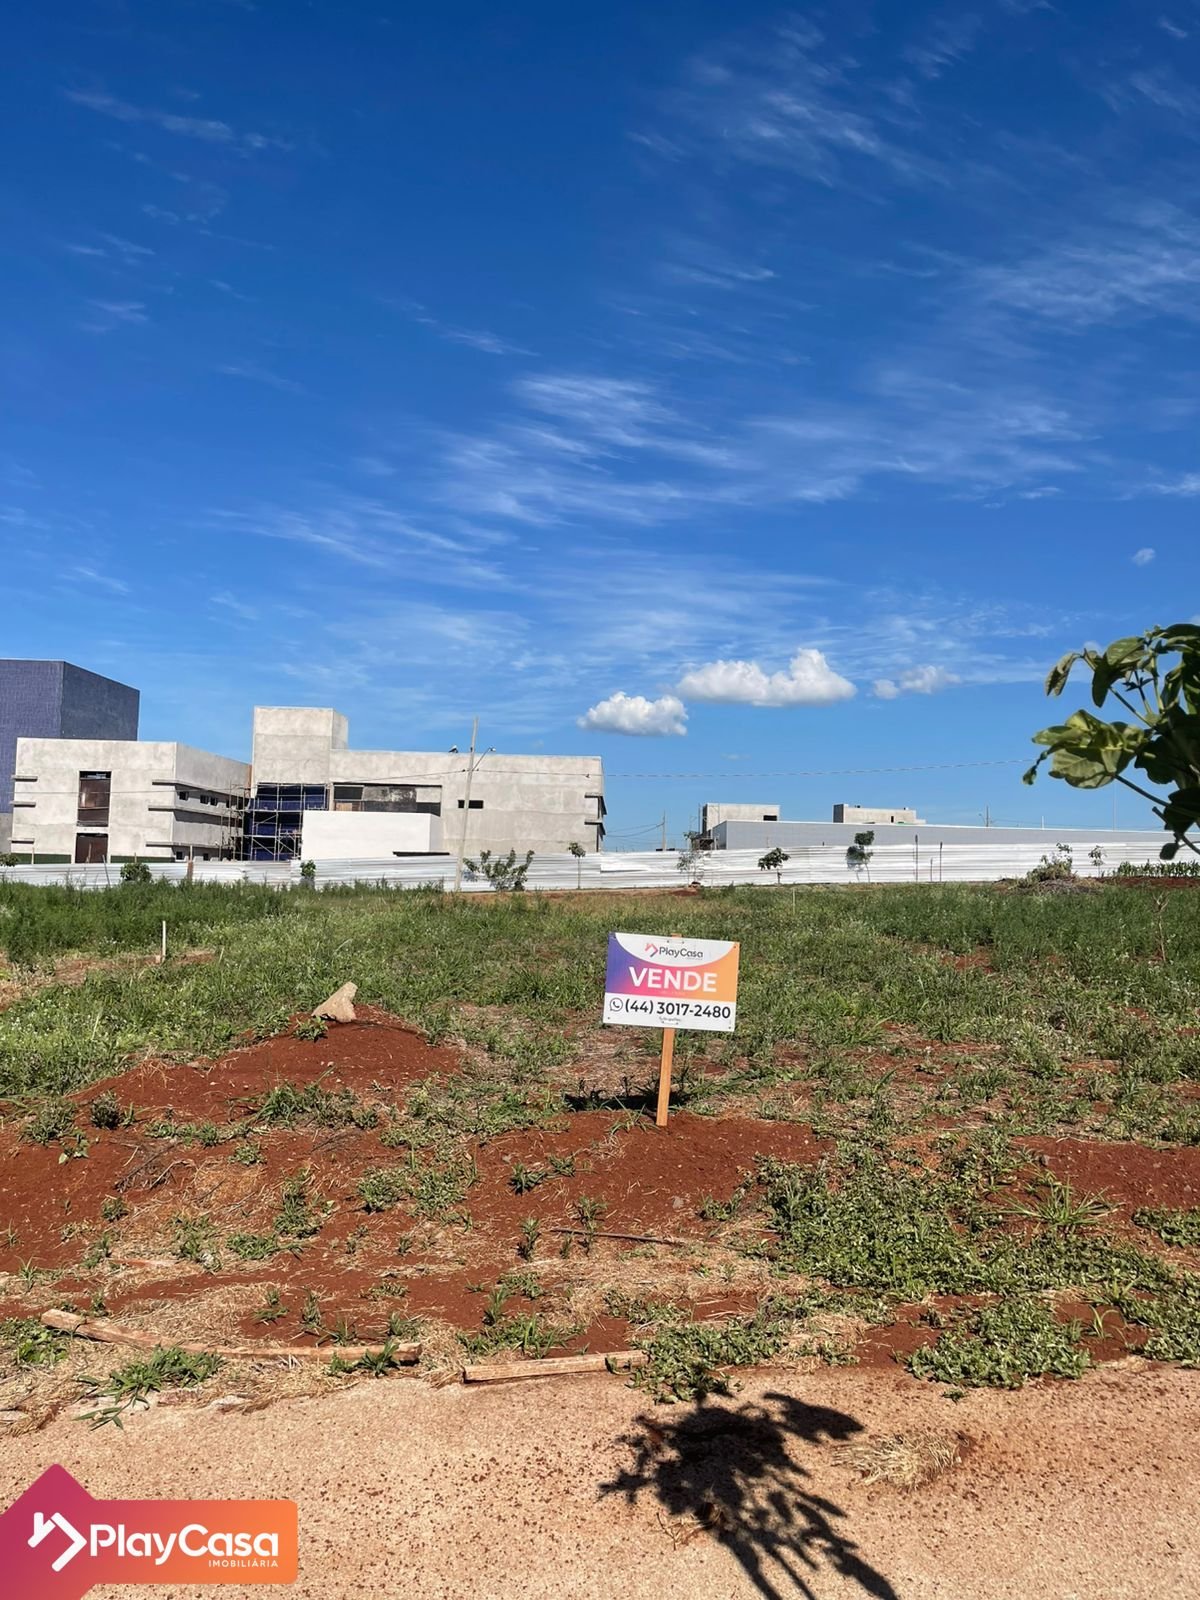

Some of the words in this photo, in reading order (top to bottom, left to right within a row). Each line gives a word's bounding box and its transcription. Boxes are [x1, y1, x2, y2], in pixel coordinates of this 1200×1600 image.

[659, 946, 704, 959] PlayCasa
[628, 966, 718, 993] VENDE
[625, 998, 654, 1015] (44)
[656, 1001, 732, 1020] 3017-2480
